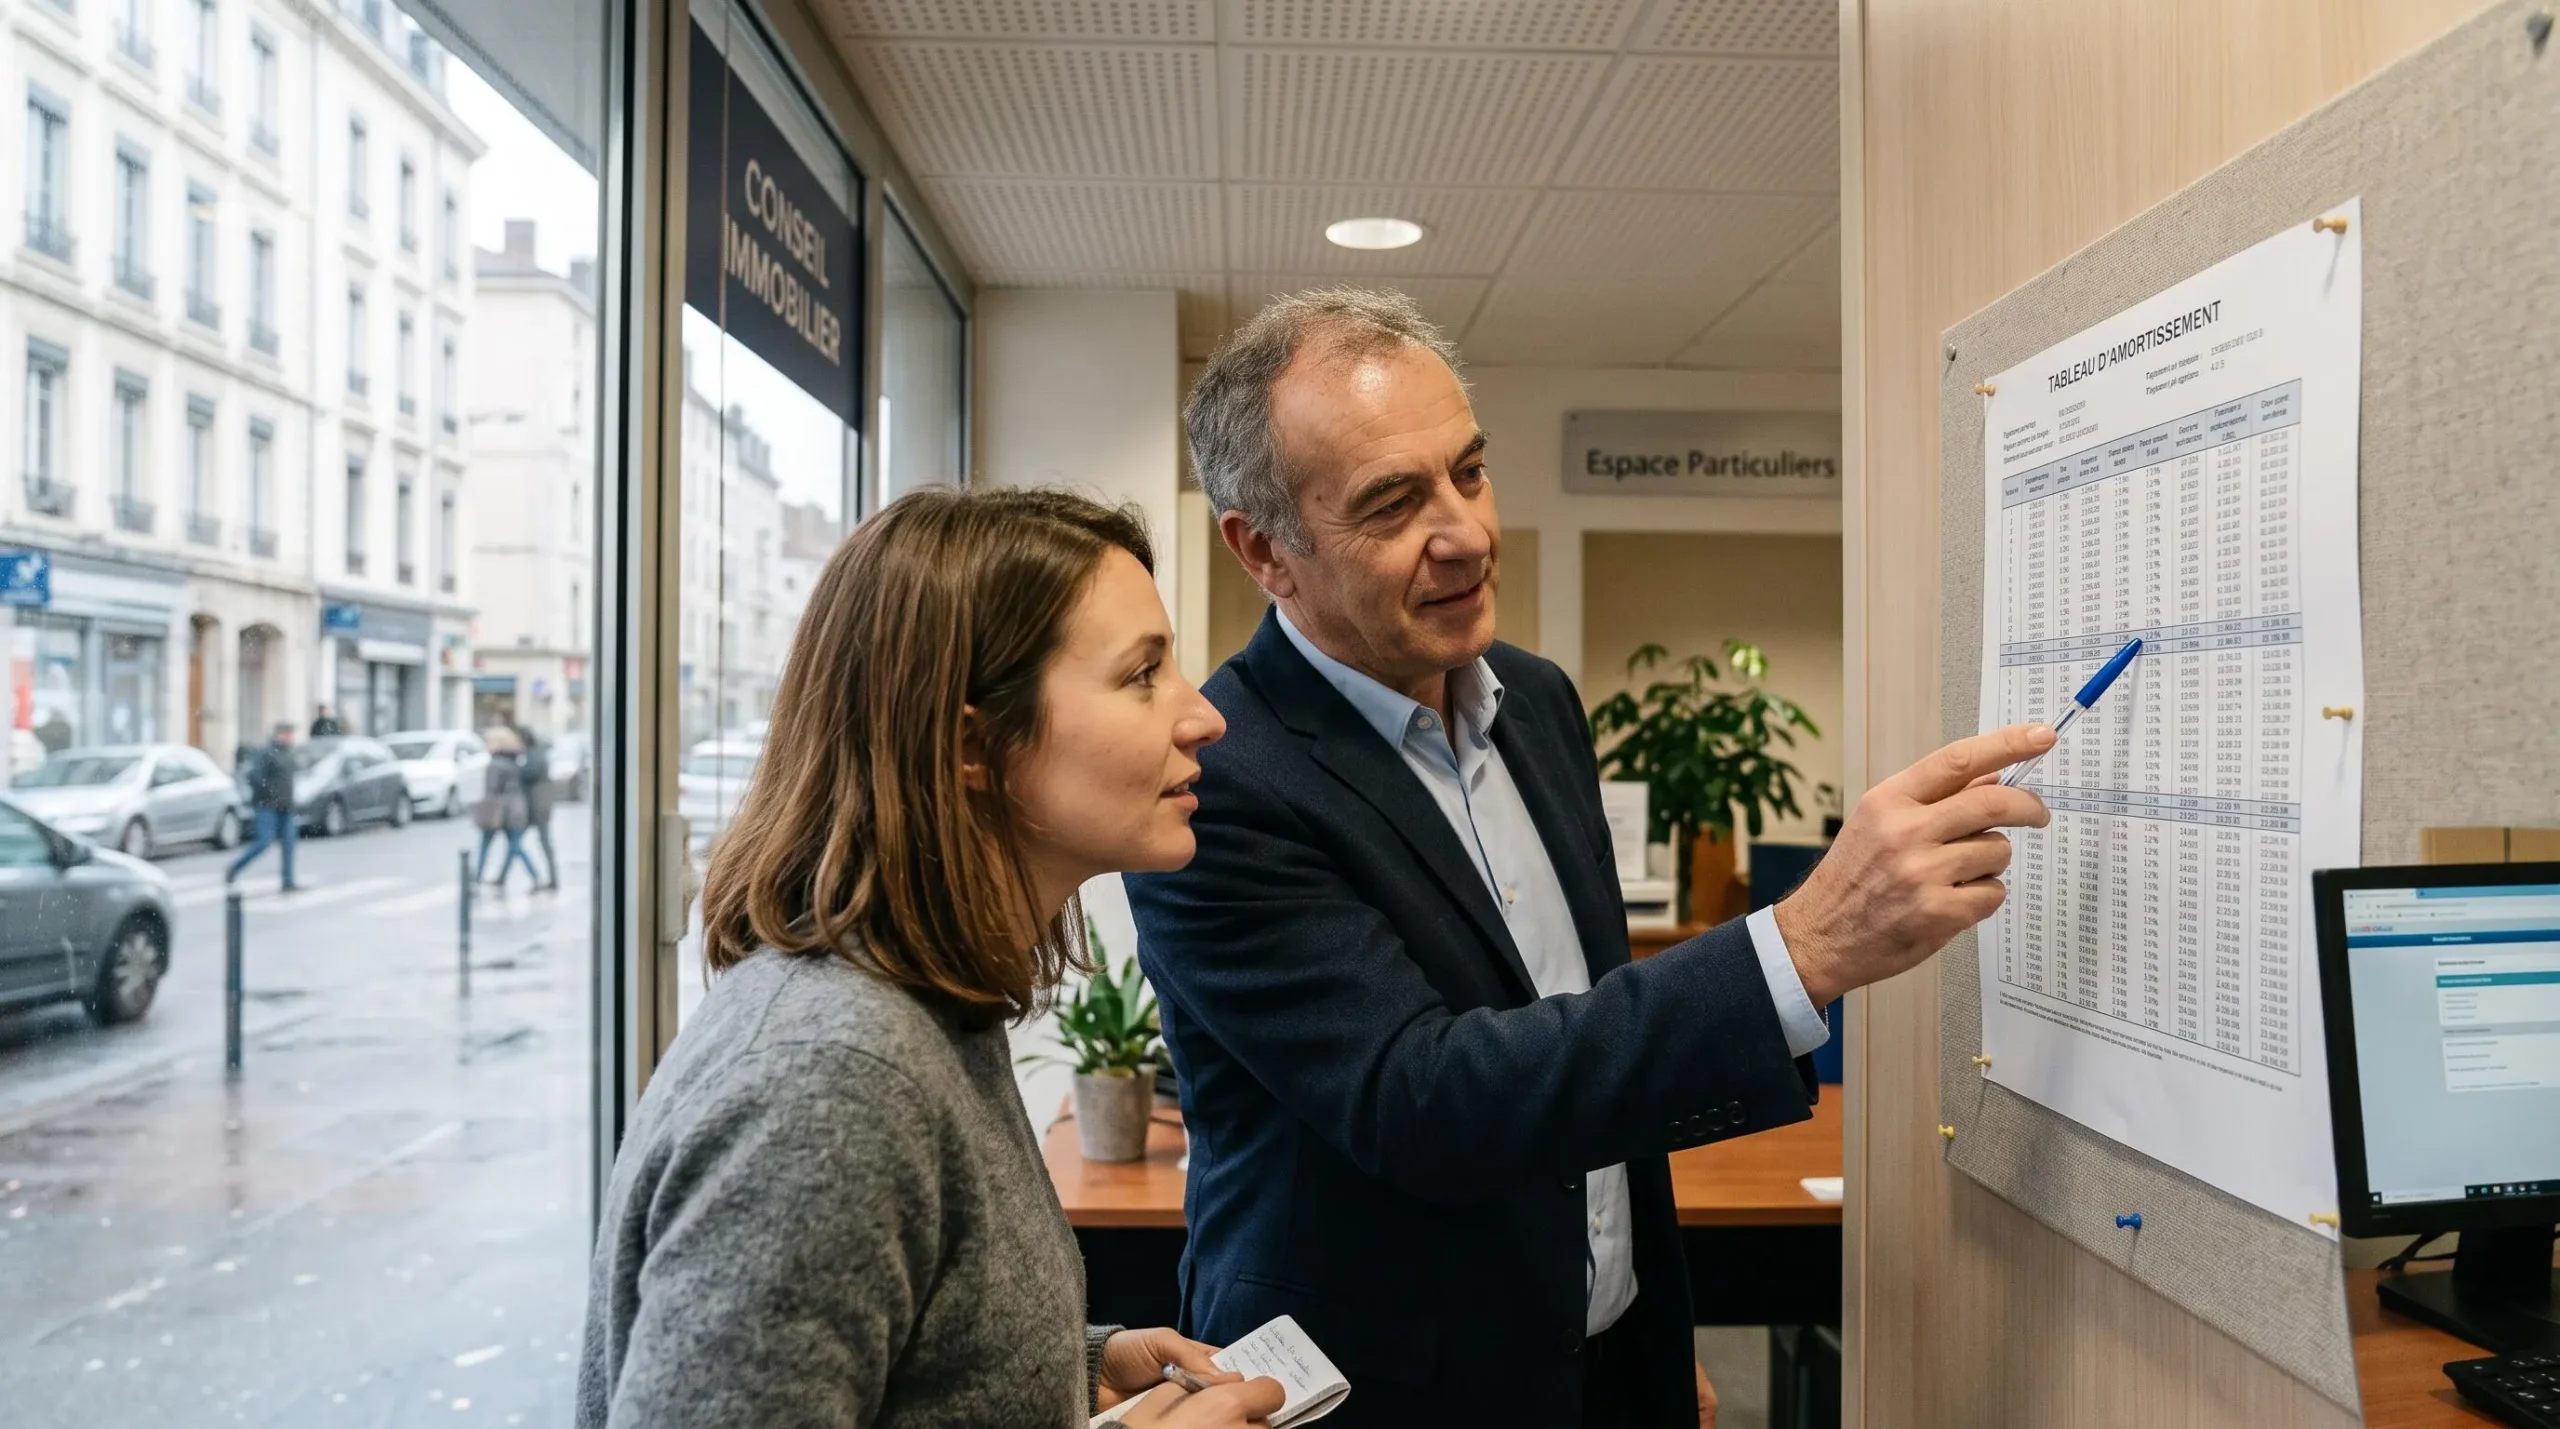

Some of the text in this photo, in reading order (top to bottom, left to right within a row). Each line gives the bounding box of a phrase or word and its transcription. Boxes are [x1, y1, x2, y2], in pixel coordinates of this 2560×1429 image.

[745, 159, 829, 289] CONSEIL
[723, 213, 841, 367] IMMOBILIER
[2048, 357, 2095, 394] TABLEAU
[2098, 300, 2221, 371] D'AMORTISSEMENT
[1586, 449, 1837, 482] Espace Particuliers
